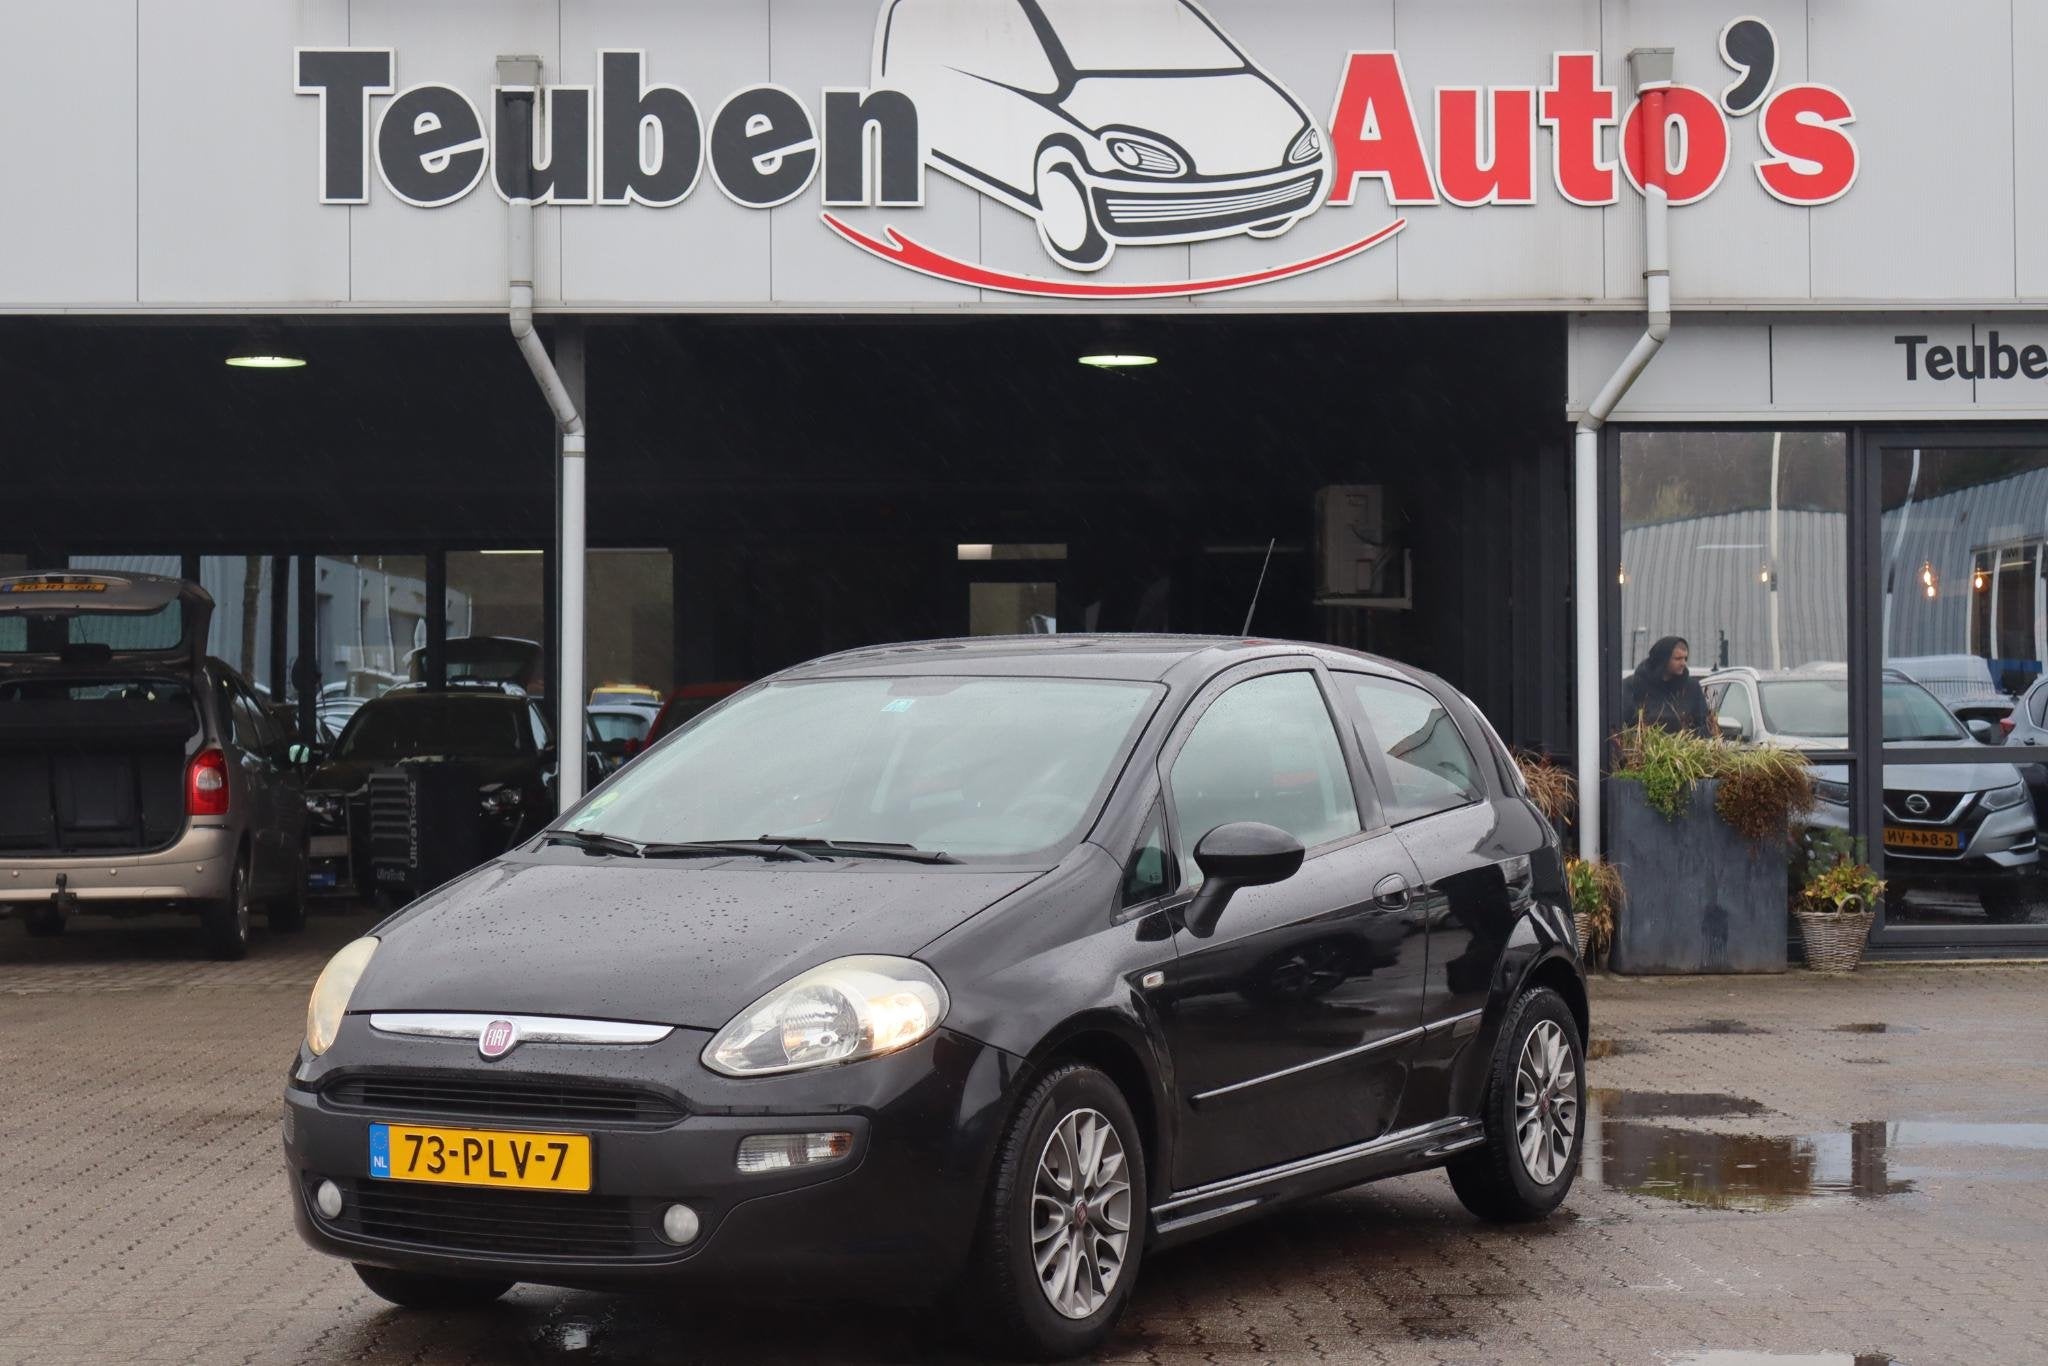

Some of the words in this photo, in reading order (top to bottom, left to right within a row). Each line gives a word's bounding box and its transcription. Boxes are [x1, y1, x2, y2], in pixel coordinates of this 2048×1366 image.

[296, 48, 924, 208] Teuben
[1327, 16, 1860, 206] Auto's
[1895, 331, 2048, 381] Teube
[486, 1029, 510, 1046] FIAT
[373, 1155, 388, 1168] NL
[404, 1134, 569, 1181] 73-PLV-7
